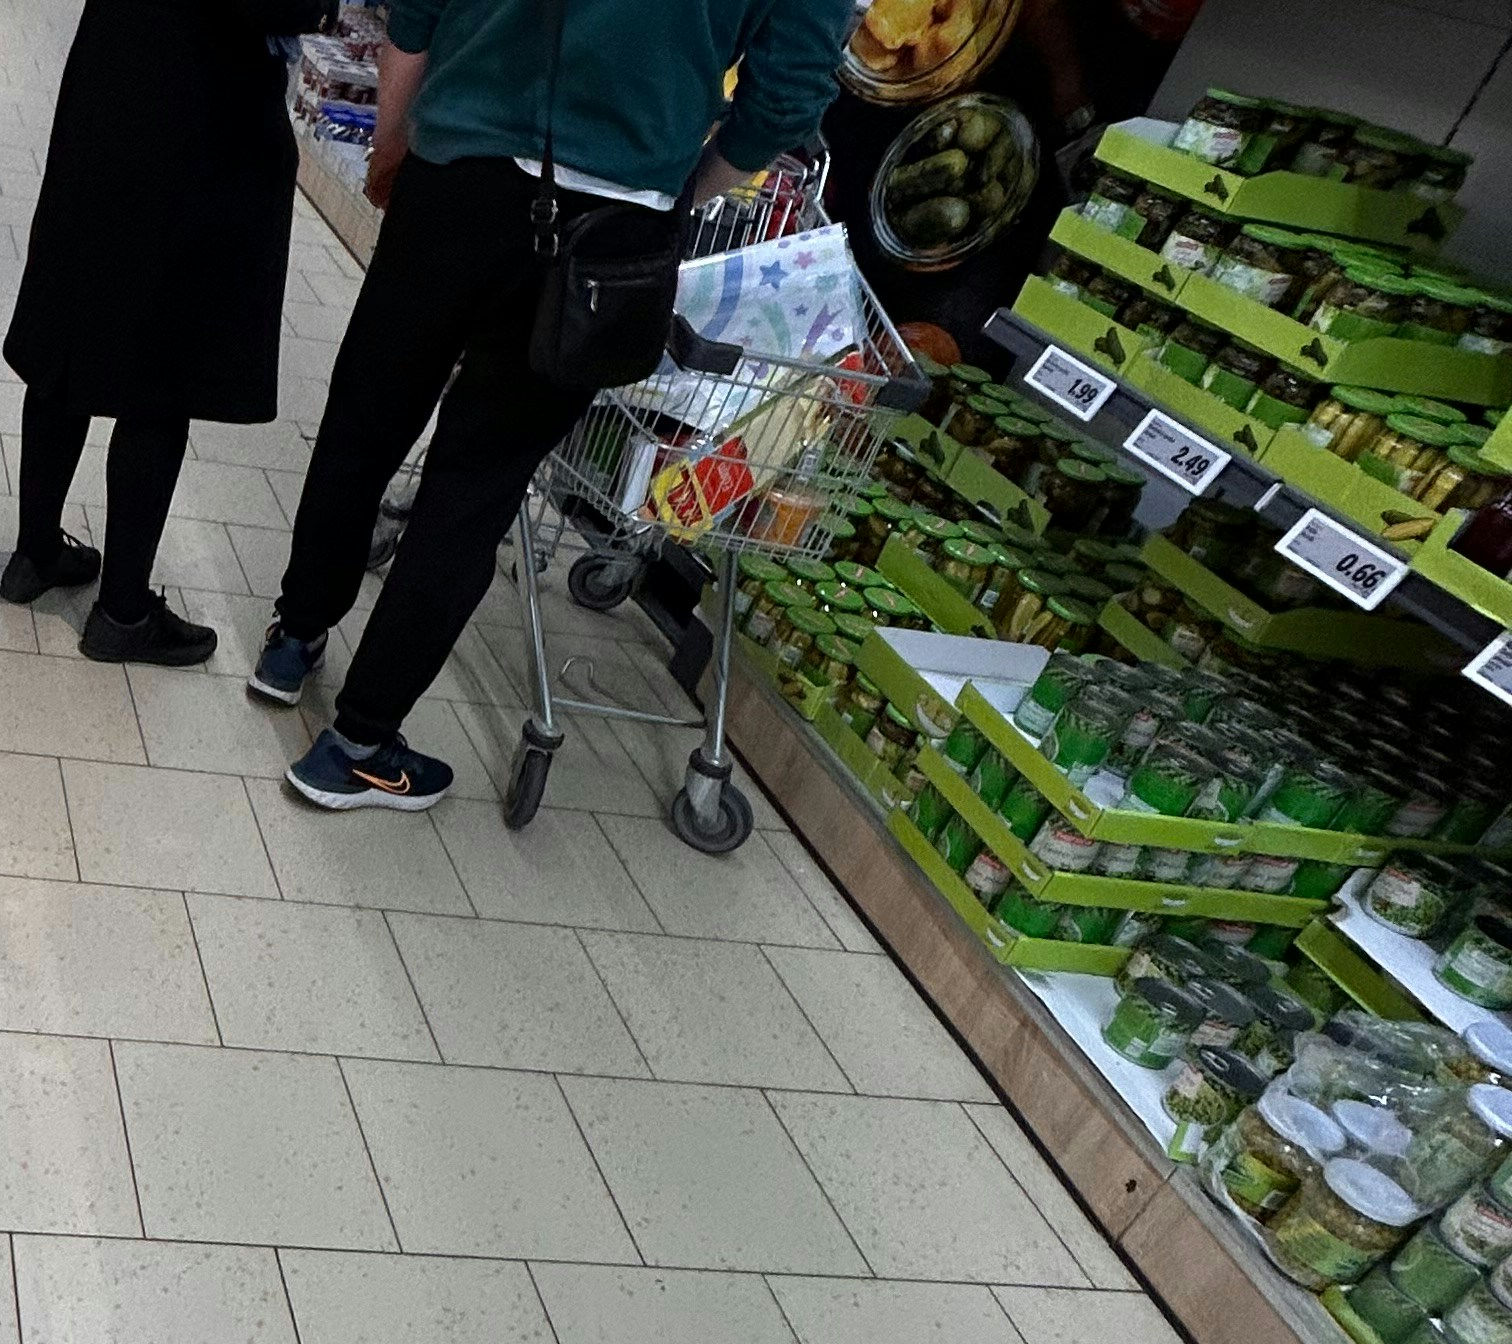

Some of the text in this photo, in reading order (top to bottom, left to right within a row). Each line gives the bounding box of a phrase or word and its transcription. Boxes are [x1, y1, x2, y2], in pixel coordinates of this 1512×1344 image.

[1067, 377, 1100, 405] 1.99
[1169, 445, 1211, 477] 2.49
[1334, 552, 1387, 590] 0.66
